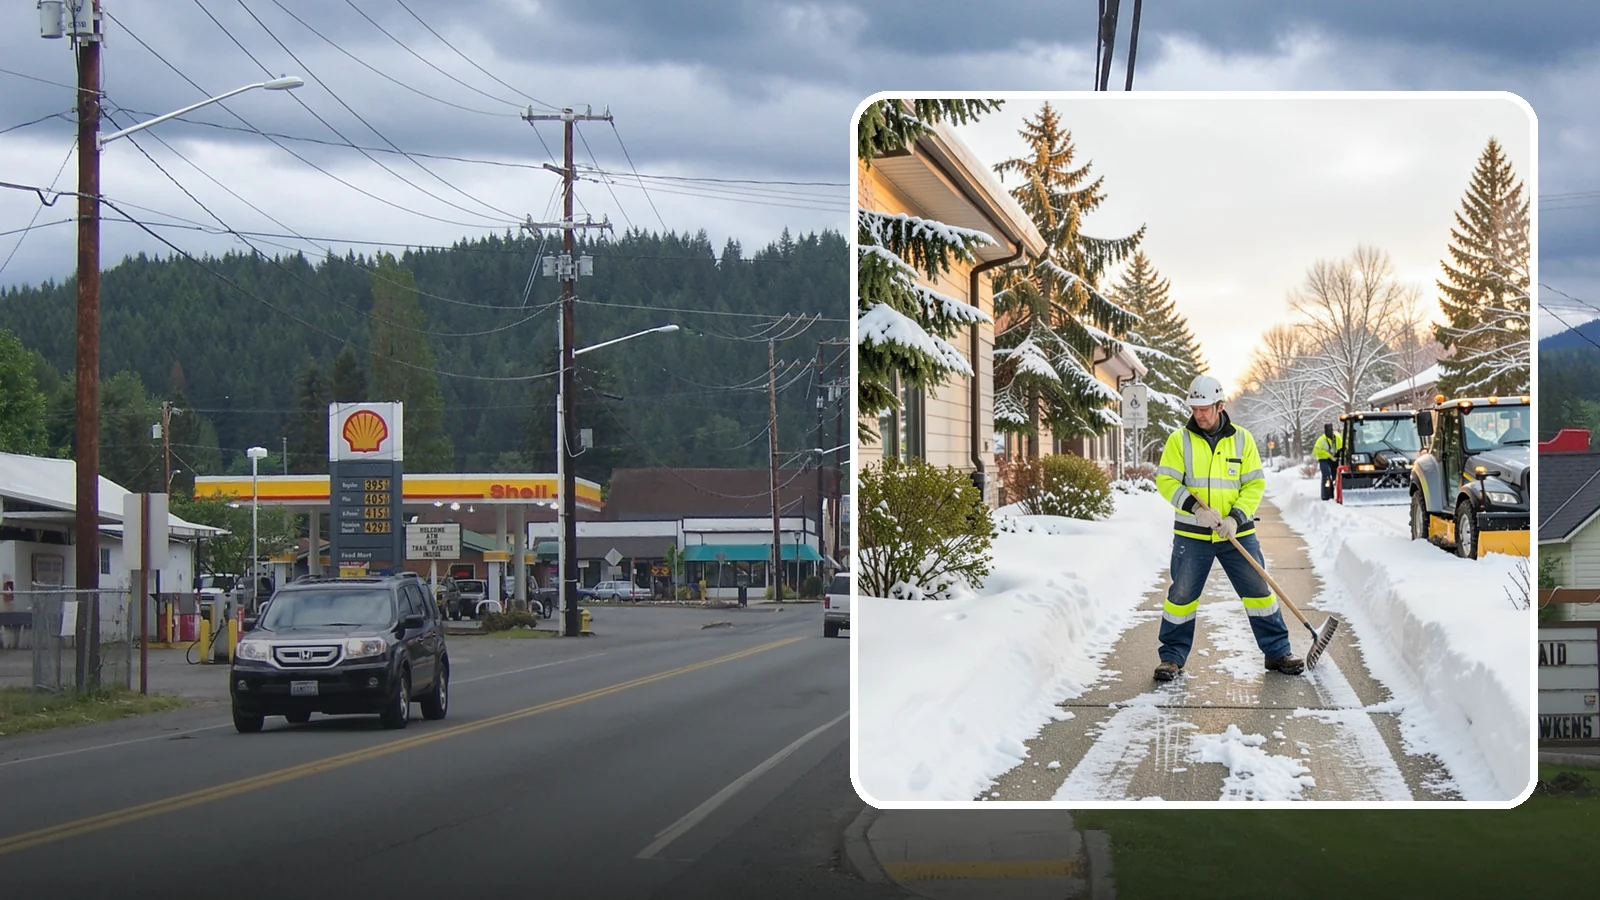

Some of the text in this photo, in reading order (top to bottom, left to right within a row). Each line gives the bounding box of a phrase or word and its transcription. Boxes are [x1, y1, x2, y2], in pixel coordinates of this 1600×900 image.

[365, 480, 383, 490] 395
[490, 484, 548, 499] Shell
[365, 494, 383, 504] 405
[365, 508, 383, 518] 415
[365, 522, 383, 532] 429
